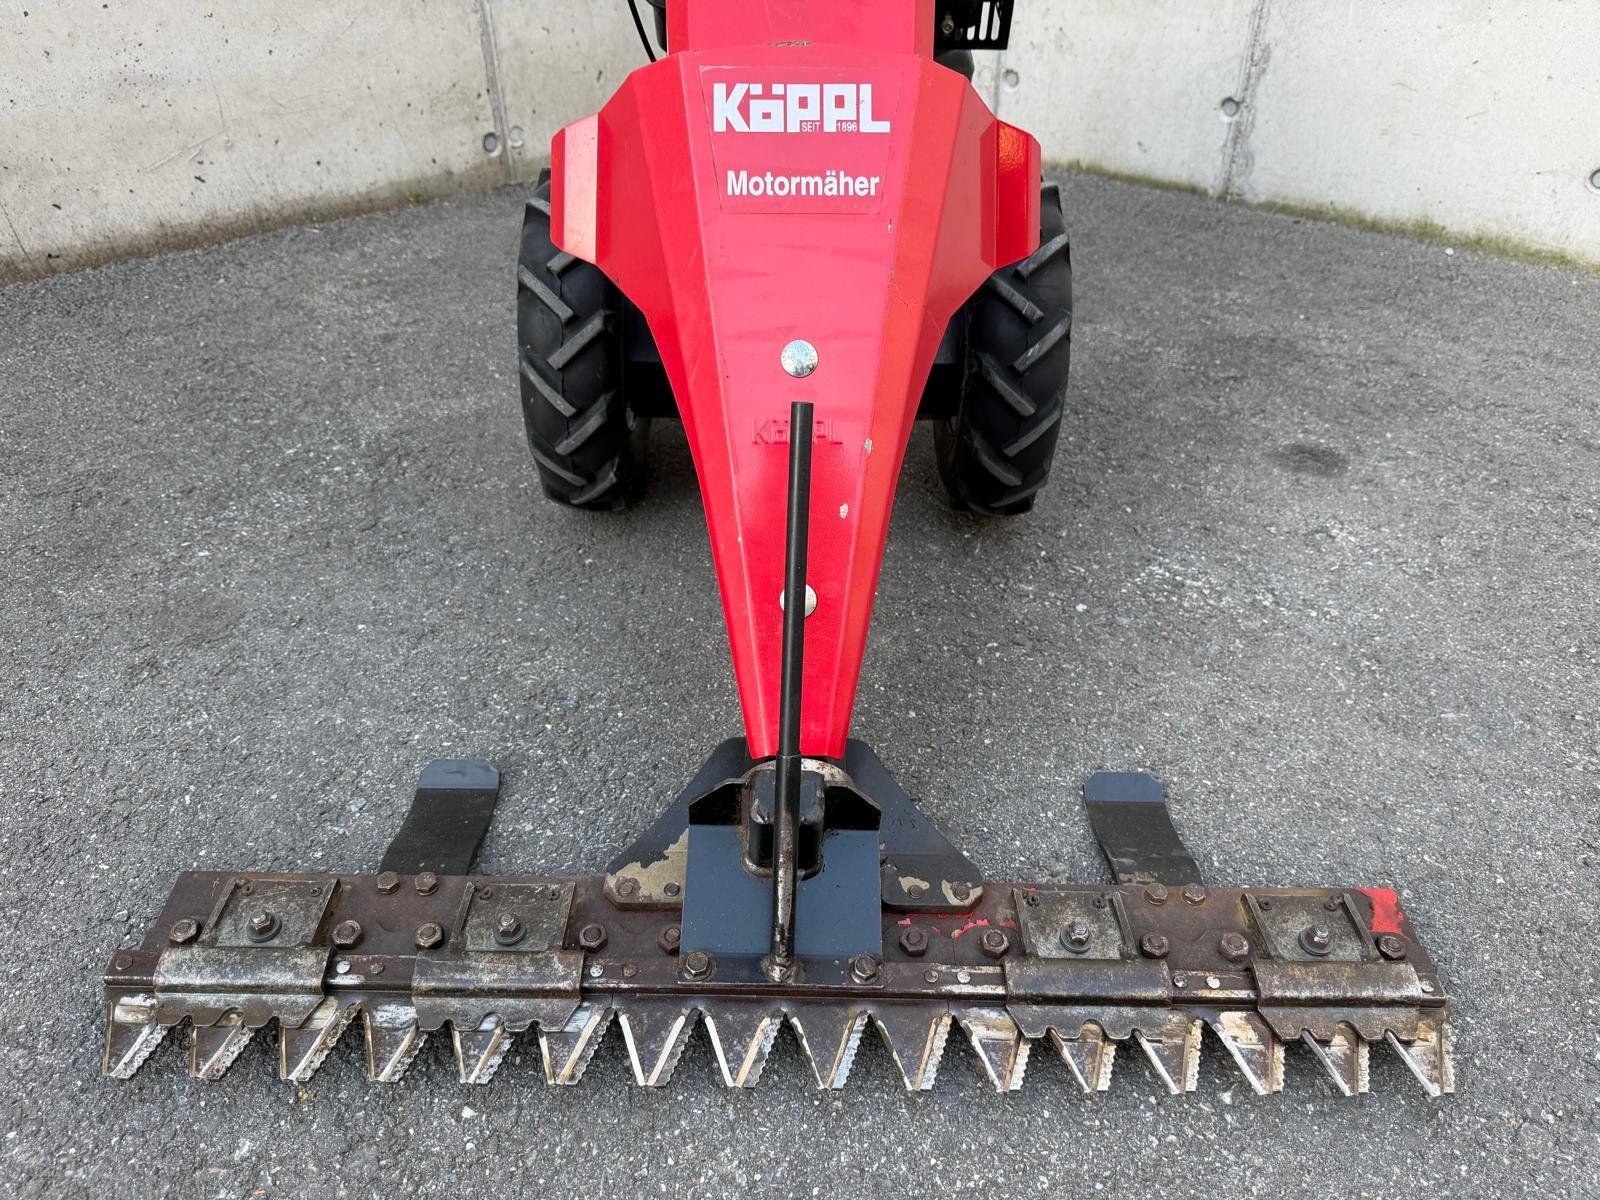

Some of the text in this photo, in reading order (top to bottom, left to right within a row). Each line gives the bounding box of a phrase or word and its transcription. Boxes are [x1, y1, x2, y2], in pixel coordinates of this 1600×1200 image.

[713, 82, 891, 133] KÖPPL
[801, 121, 858, 132] SEIT 1896
[727, 170, 880, 196] Motormäher
[752, 417, 843, 445] KÖPL
